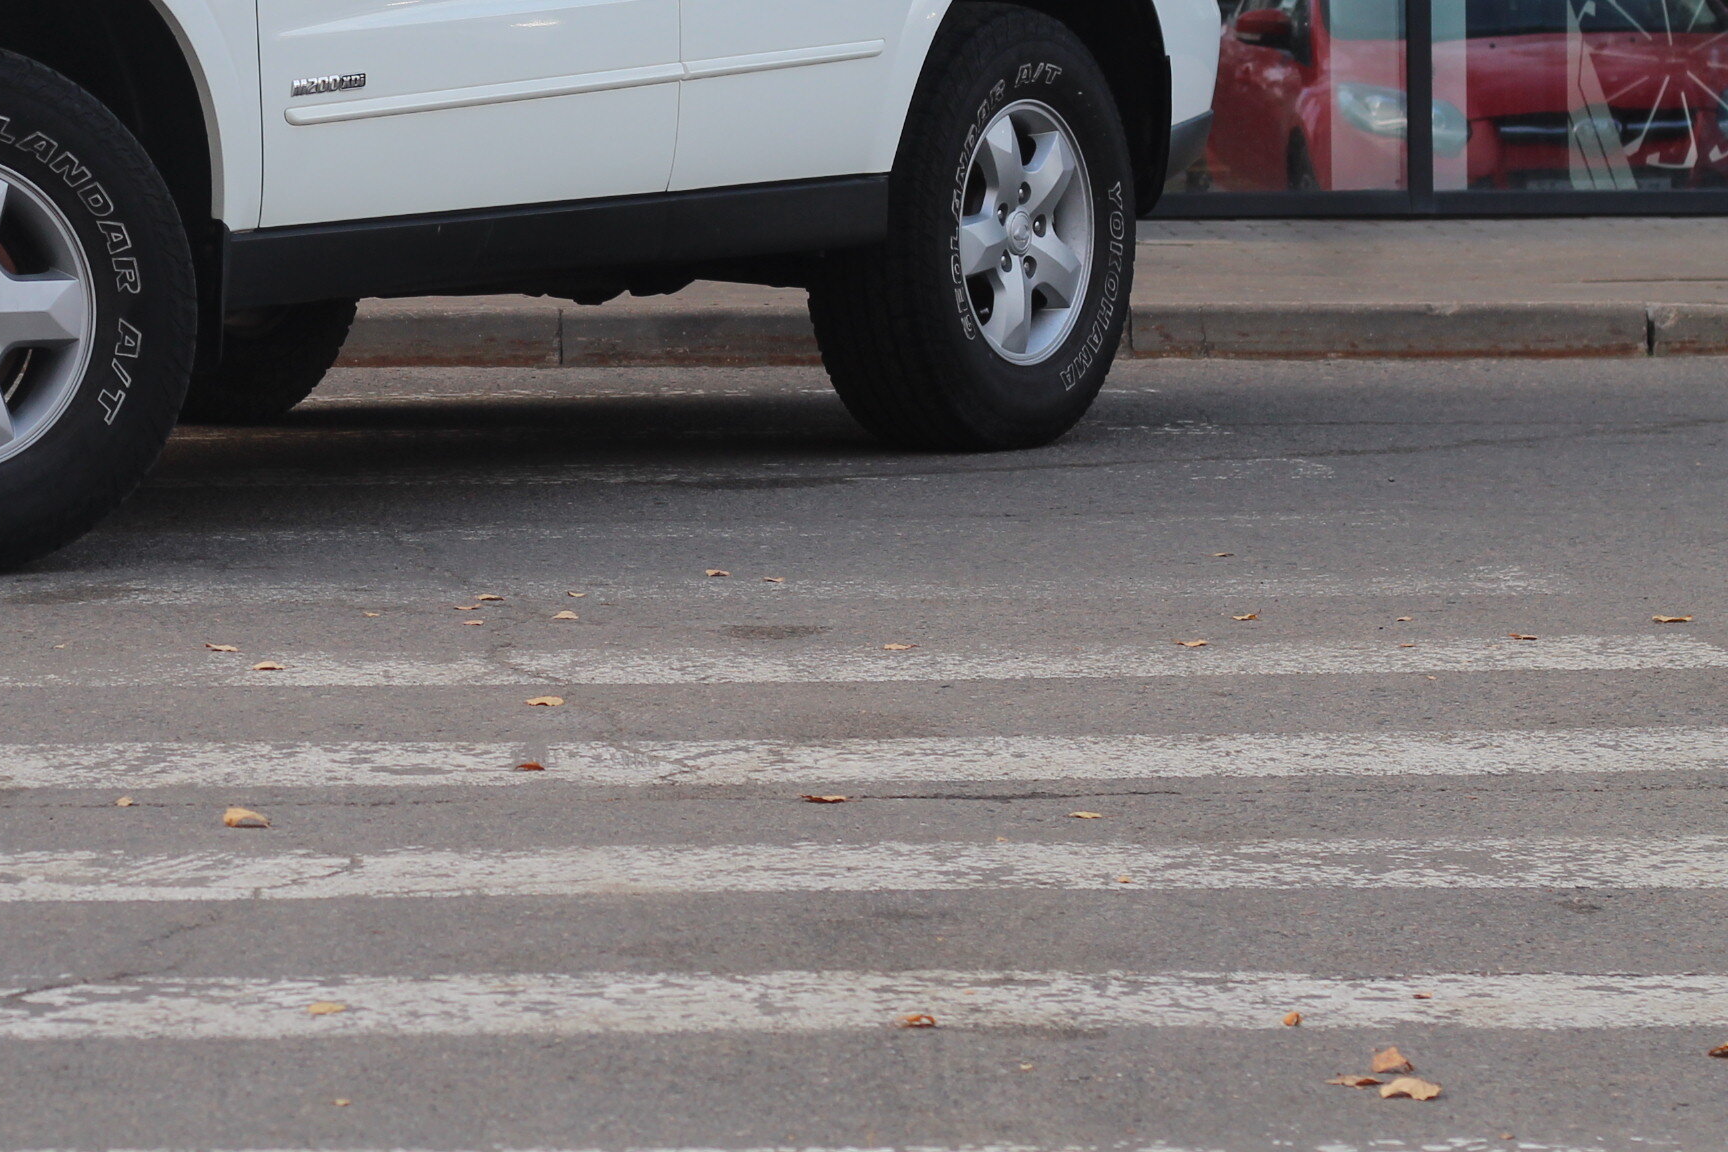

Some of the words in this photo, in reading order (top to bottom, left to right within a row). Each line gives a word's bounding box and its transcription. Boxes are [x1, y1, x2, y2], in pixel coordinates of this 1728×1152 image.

[1014, 61, 1063, 88] A/T
[1058, 180, 1126, 392] YOKOHAMA
[95, 317, 143, 426] A/T
